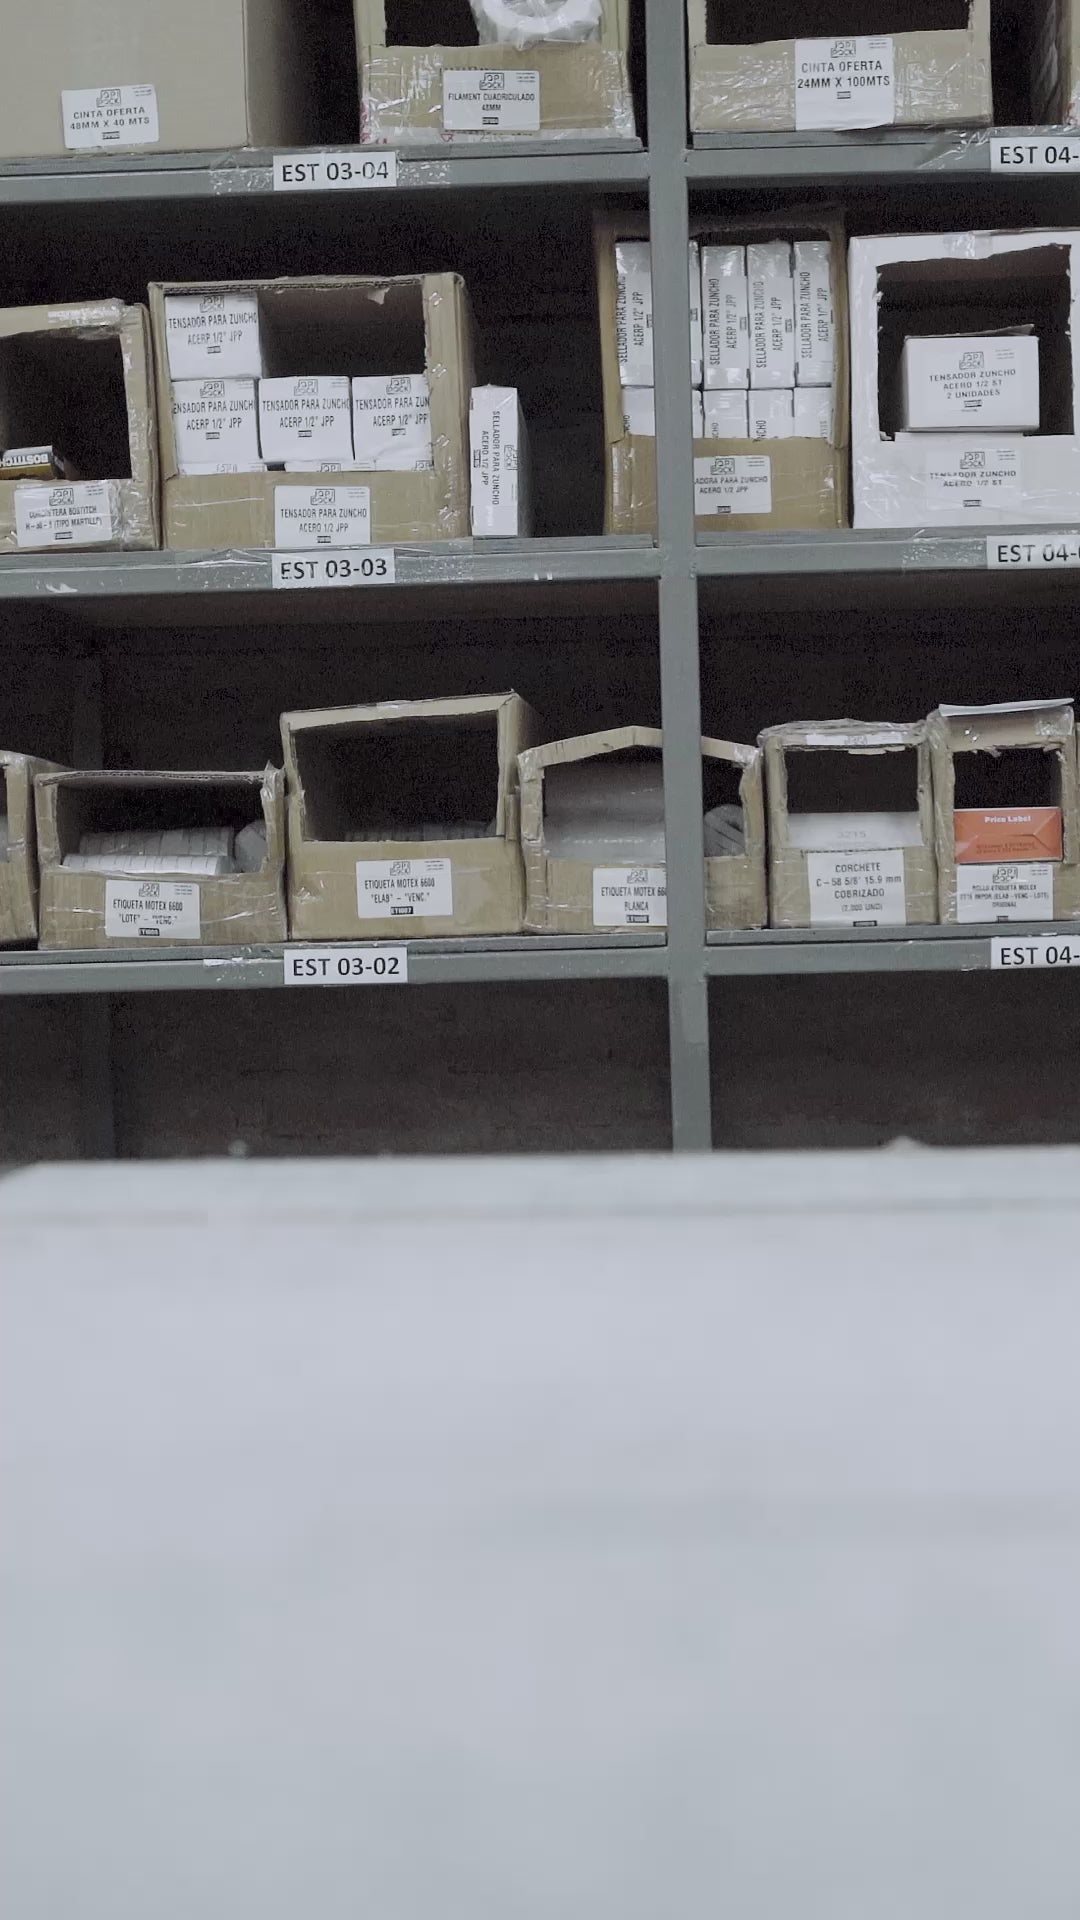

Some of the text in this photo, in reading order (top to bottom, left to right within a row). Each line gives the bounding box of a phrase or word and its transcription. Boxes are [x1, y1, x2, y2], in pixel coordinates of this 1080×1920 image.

[801, 60, 883, 73] CINTA OFERTA
[797, 75, 890, 89] 24MM X 100MTS
[448, 92, 535, 101] FILAMENT CUADRICULADO
[73, 106, 146, 120] CINTA OFERTA
[70, 117, 150, 130] 48MM X 40 MTS
[1000, 146, 1038, 164] EST
[282, 161, 388, 182] EST 03-04
[632, 292, 643, 305] JPP
[817, 287, 828, 300] JPP
[726, 294, 737, 307] JPP
[771, 297, 782, 310] JPP
[168, 316, 206, 328] TENSADOR
[208, 314, 227, 325] PARA
[616, 306, 626, 325] PARA
[755, 310, 766, 331] PARA
[800, 271, 812, 358] SELLADOR PARA ZUNCHO
[709, 278, 721, 365] SELLADOR PARA ZUNCHO
[230, 330, 242, 342] JPP
[617, 327, 628, 363] SELLADOR
[755, 333, 767, 368] SELLADOR
[929, 369, 1016, 382] TENSADOR ZUNCHO
[943, 381, 972, 390] ACERO
[977, 380, 989, 388] 1/2
[955, 390, 1000, 398] UNIDADES
[208, 400, 227, 412] PARA
[262, 399, 299, 411] TENSADOR
[301, 399, 320, 410] PARA
[356, 398, 392, 410] TENSADOR
[395, 398, 413, 408] PARA
[229, 417, 242, 428] JPP
[321, 416, 334, 427] JPP
[492, 410, 500, 505] SELLADOR PARA ZUNCHO
[980, 470, 1016, 478] ZUNCHO
[69, 506, 97, 515] BOSTITCH
[281, 508, 367, 518] TENSADOR PARA ZUNCHO
[299, 522, 348, 533] ACERO 1/2 JPP
[998, 544, 1080, 562] EST 04-
[281, 558, 388, 579] EST 03-03
[835, 862, 881, 873] CORCHETE
[365, 879, 395, 889] ETIQUETA
[397, 878, 418, 888] MOTEX
[864, 875, 882, 885] 15.9
[885, 875, 902, 883] mm
[601, 886, 632, 896] ETIQUETA
[634, 886, 655, 896] MOTEX
[834, 888, 885, 899] COBRIZADO
[113, 899, 183, 911] ETIQUETA MOTEX 6600
[624, 901, 648, 911] BLANCA
[1001, 946, 1080, 965] EST 04-
[293, 957, 400, 976] EST 03-02
